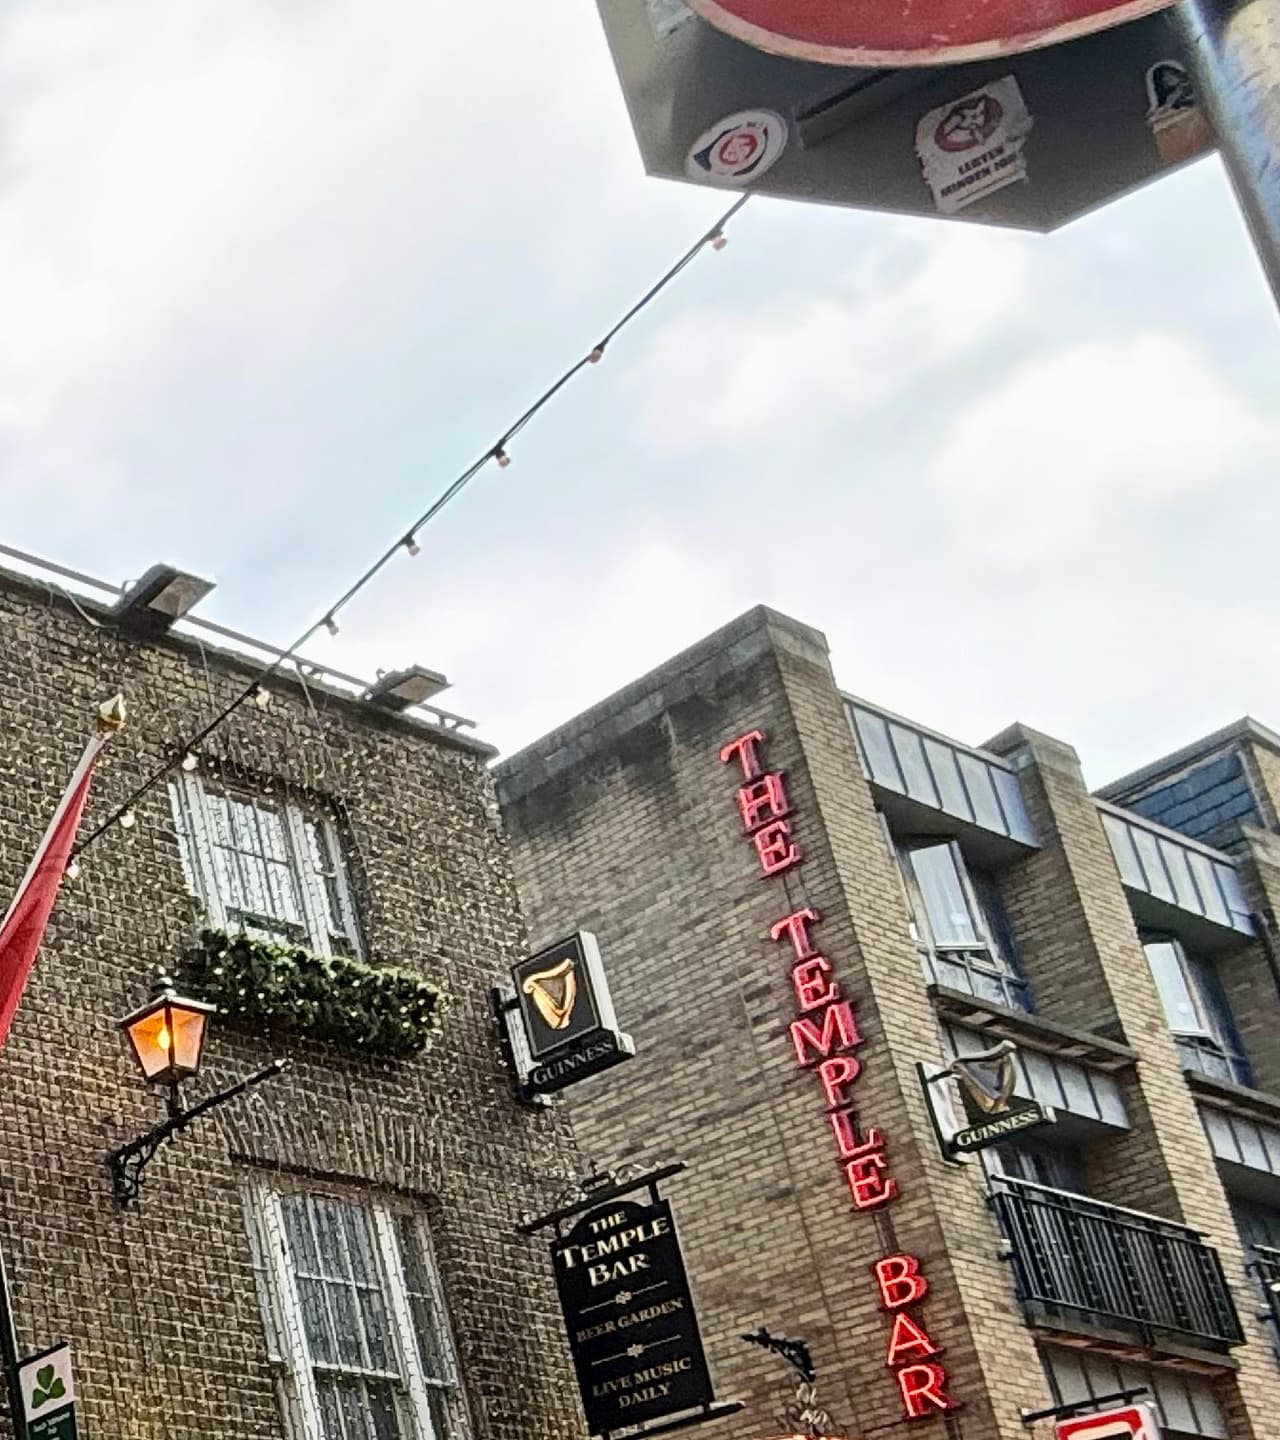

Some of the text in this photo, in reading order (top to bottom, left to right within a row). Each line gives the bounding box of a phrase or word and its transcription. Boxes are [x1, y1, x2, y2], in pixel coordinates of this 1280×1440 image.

[532, 1039, 614, 1085] GUINNESS
[719, 729, 954, 1422] THE TEMPLE BAR
[956, 1109, 1039, 1147] GUINNESS
[556, 1216, 671, 1269] TEMPLE
[590, 1210, 628, 1234] THE
[588, 1253, 652, 1288] BAR
[576, 1297, 685, 1343] BEER GARDEN
[591, 1356, 692, 1398] LIVE MUSIC
[618, 1382, 671, 1409] DAILY
